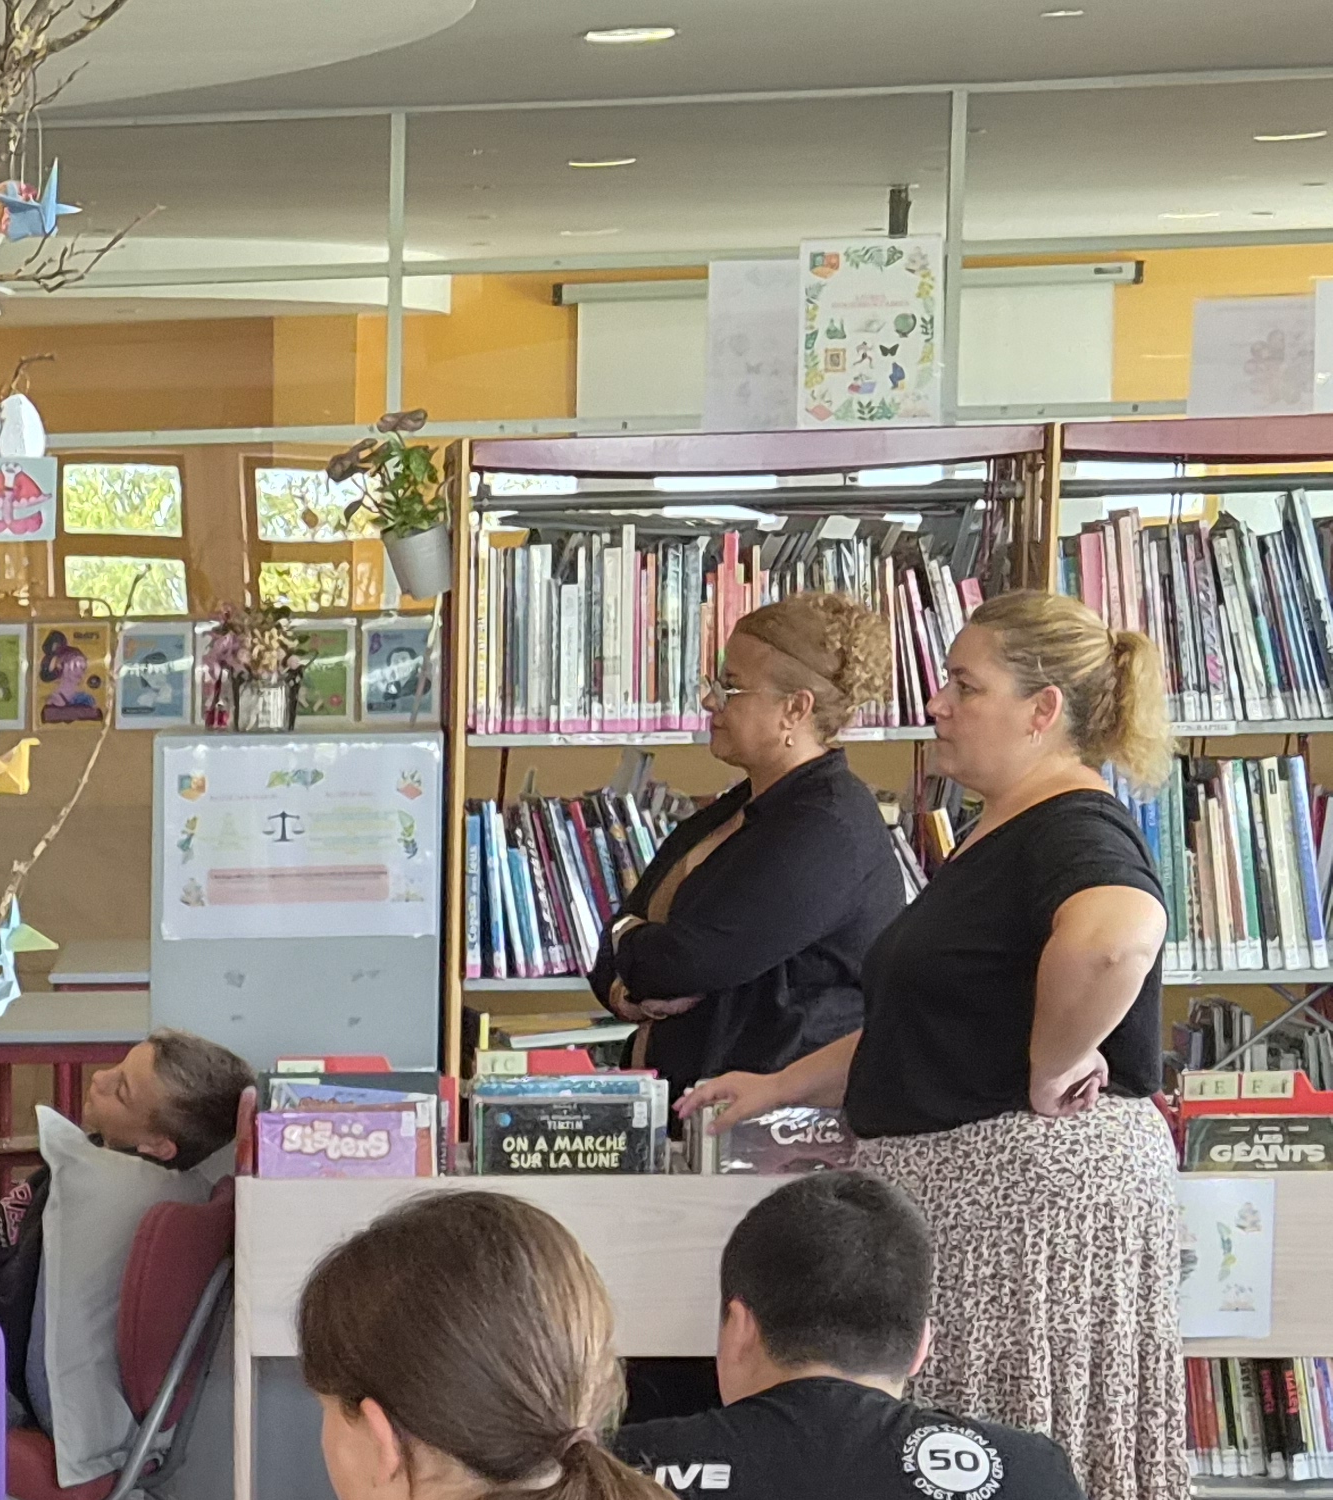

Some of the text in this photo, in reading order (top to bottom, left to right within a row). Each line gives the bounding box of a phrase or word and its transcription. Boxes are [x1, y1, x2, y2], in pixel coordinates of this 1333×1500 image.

[502, 1131, 628, 1153] ON A MARCHÉ
[1209, 1140, 1326, 1163] GÉANTS
[510, 1152, 621, 1169] SUR LA LUNE
[929, 1449, 980, 1472] 50
[985, 1447, 1004, 1480] AND
